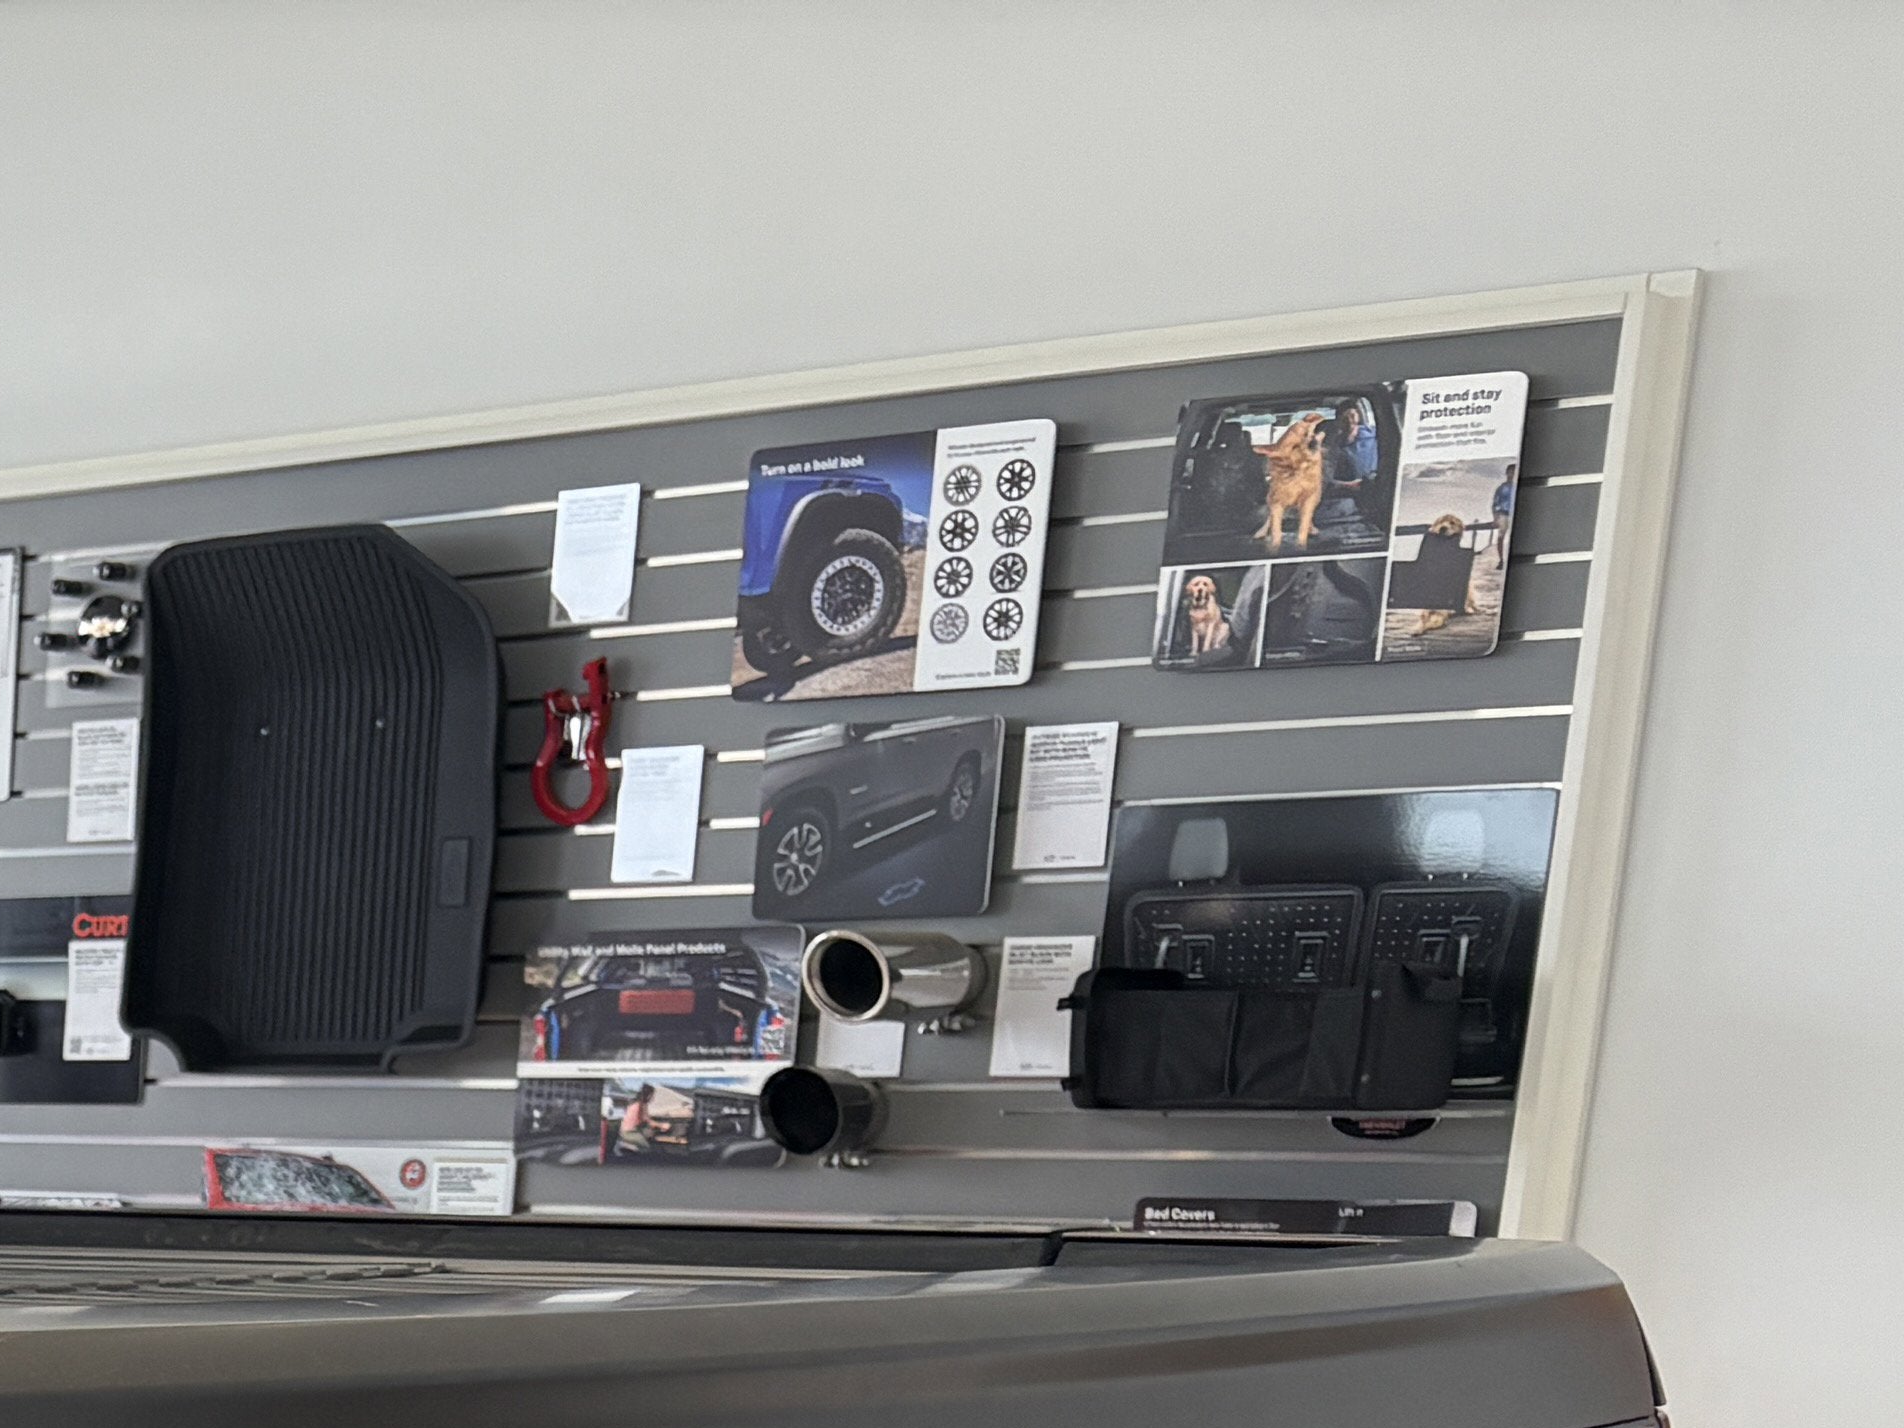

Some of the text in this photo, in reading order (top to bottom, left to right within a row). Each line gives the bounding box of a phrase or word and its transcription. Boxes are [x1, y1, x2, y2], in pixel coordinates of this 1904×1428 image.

[1421, 389, 1502, 405] Sit and stay
[1420, 403, 1492, 421] protection
